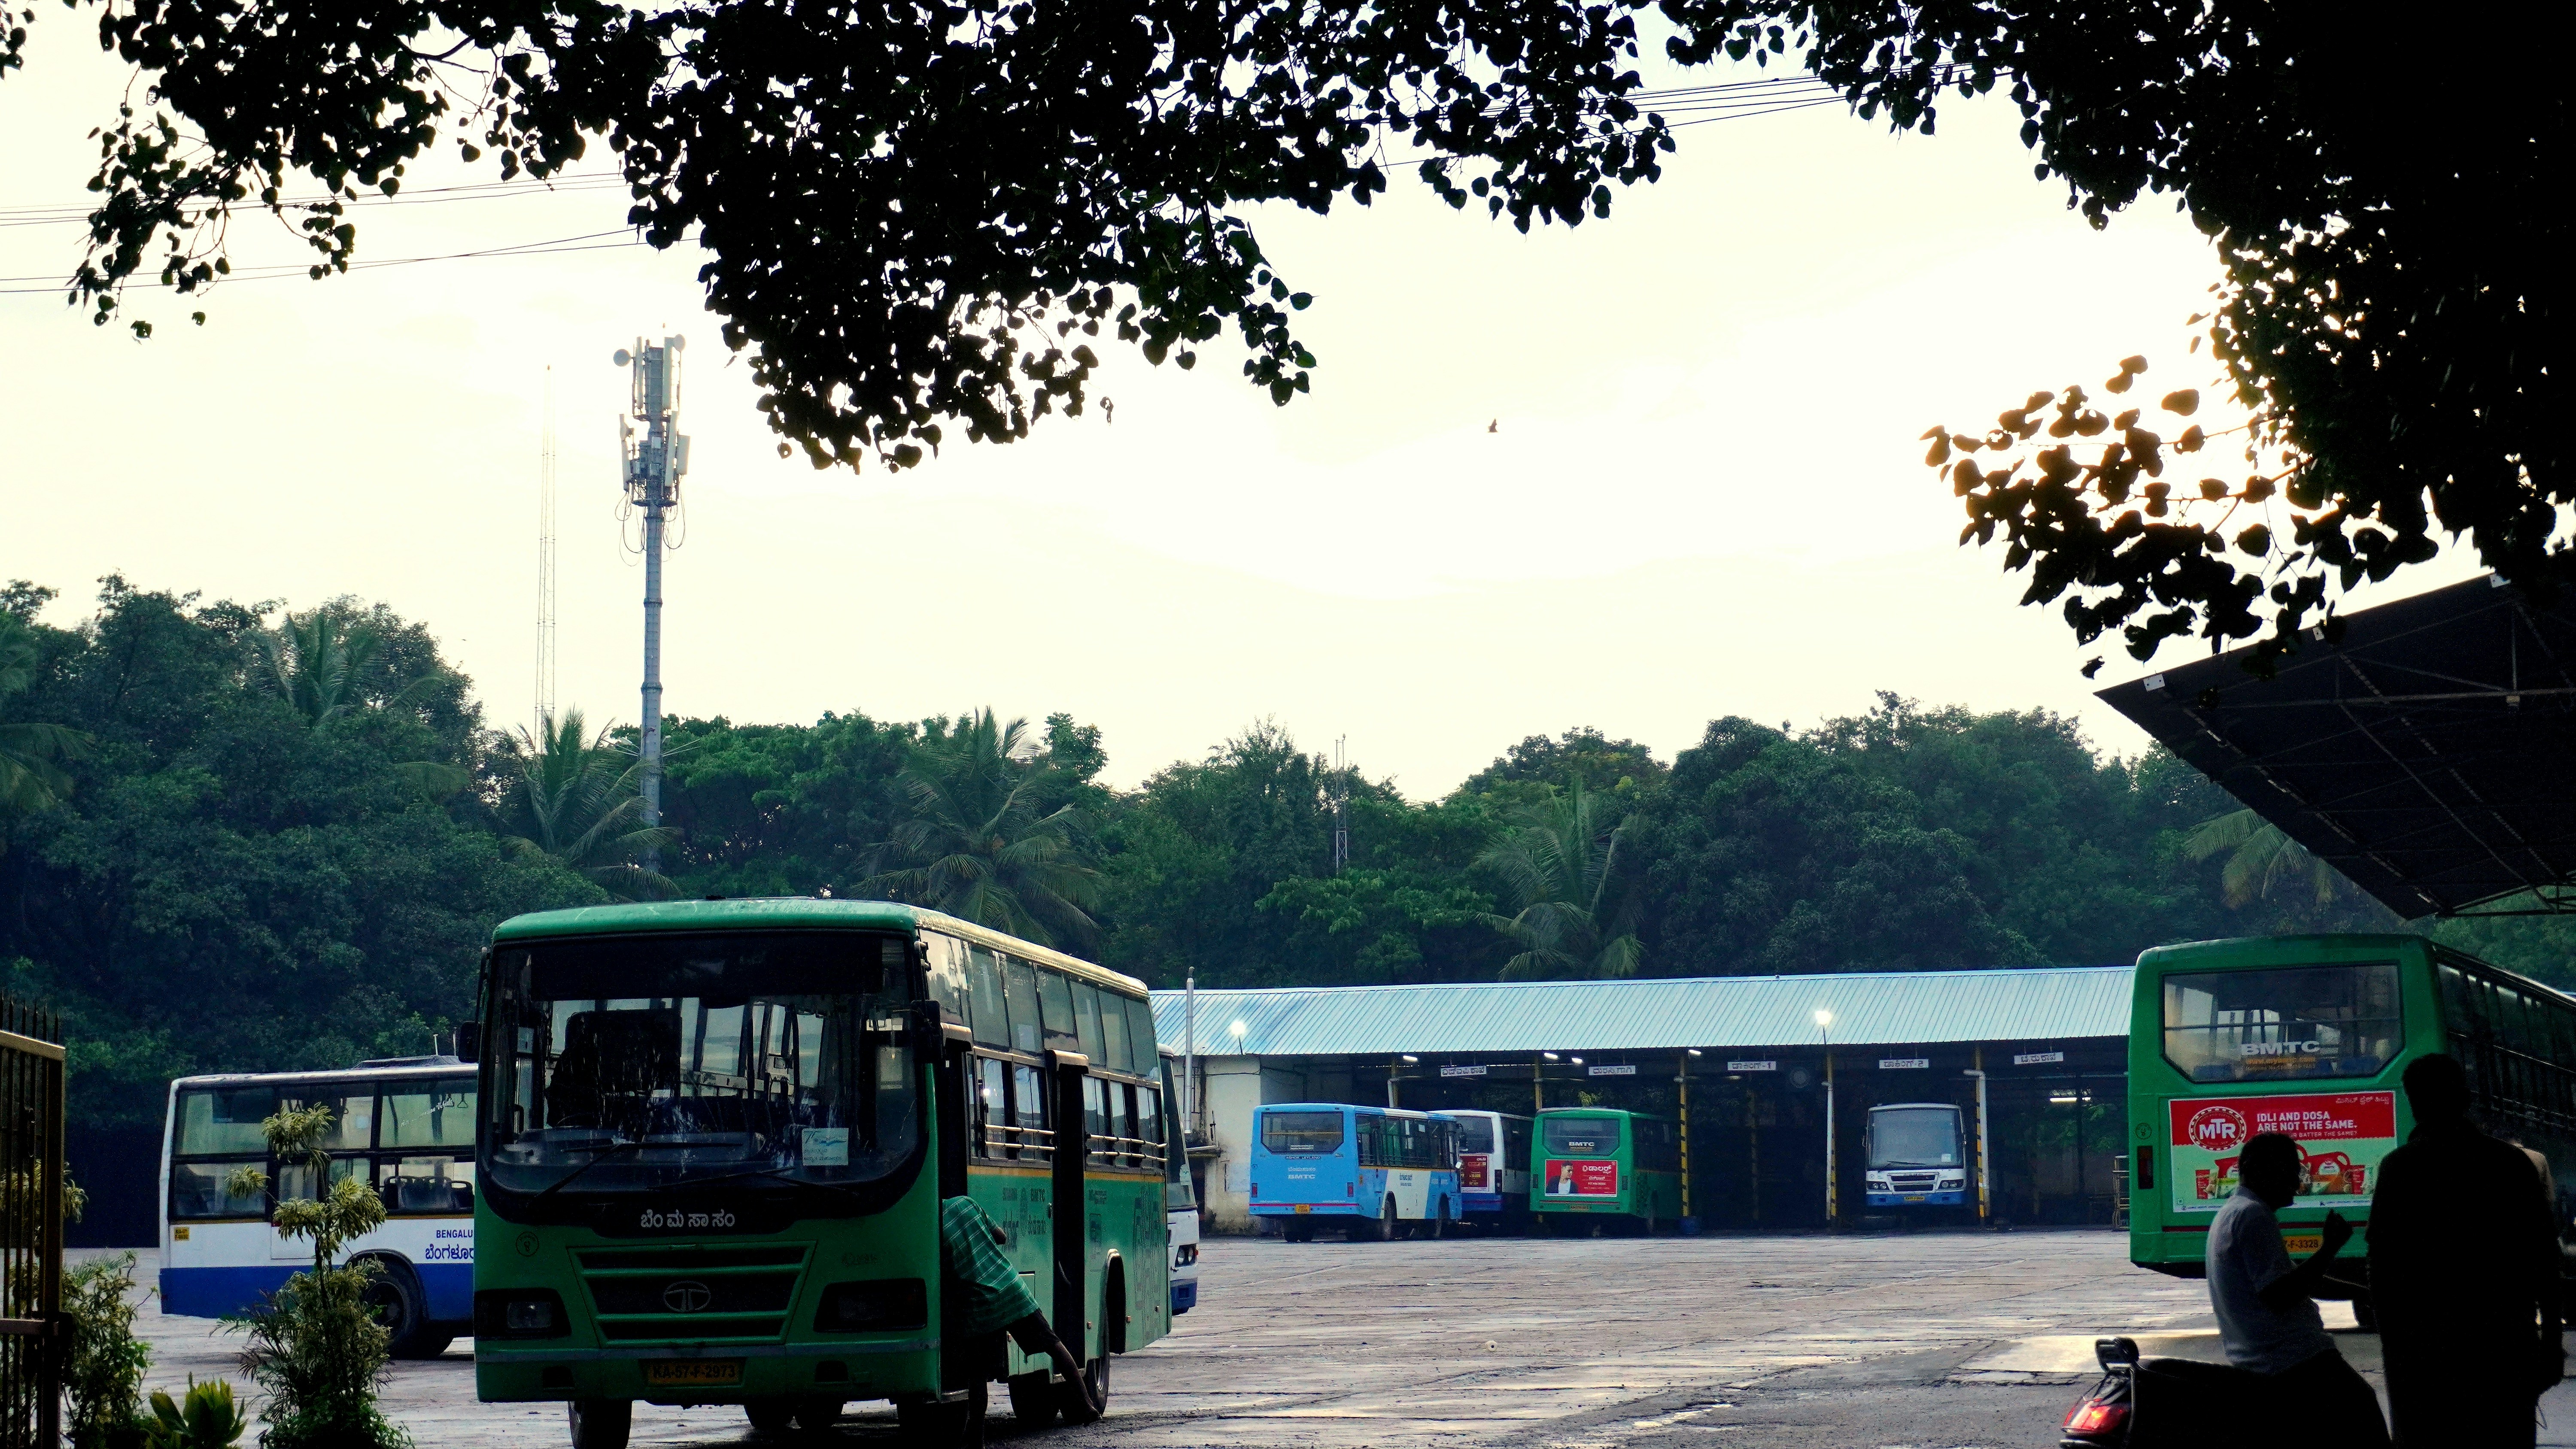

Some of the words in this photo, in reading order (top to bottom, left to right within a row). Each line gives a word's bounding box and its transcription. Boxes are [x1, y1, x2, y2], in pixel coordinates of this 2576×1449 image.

[2242, 1040, 2319, 1055] BMTC
[2257, 1113, 2276, 1122] IDLI
[2279, 1112, 2300, 1121] AND
[2303, 1111, 2330, 1120] DOSA
[2199, 1118, 2236, 1140] MTR
[2257, 1122, 2278, 1132] ARE
[2280, 1122, 2300, 1131] NOT
[2302, 1121, 2323, 1130] THE
[2325, 1119, 2357, 1129] SAME.
[436, 1230, 473, 1238] BENGALU
[653, 1364, 735, 1378] KA-57-F-2973
